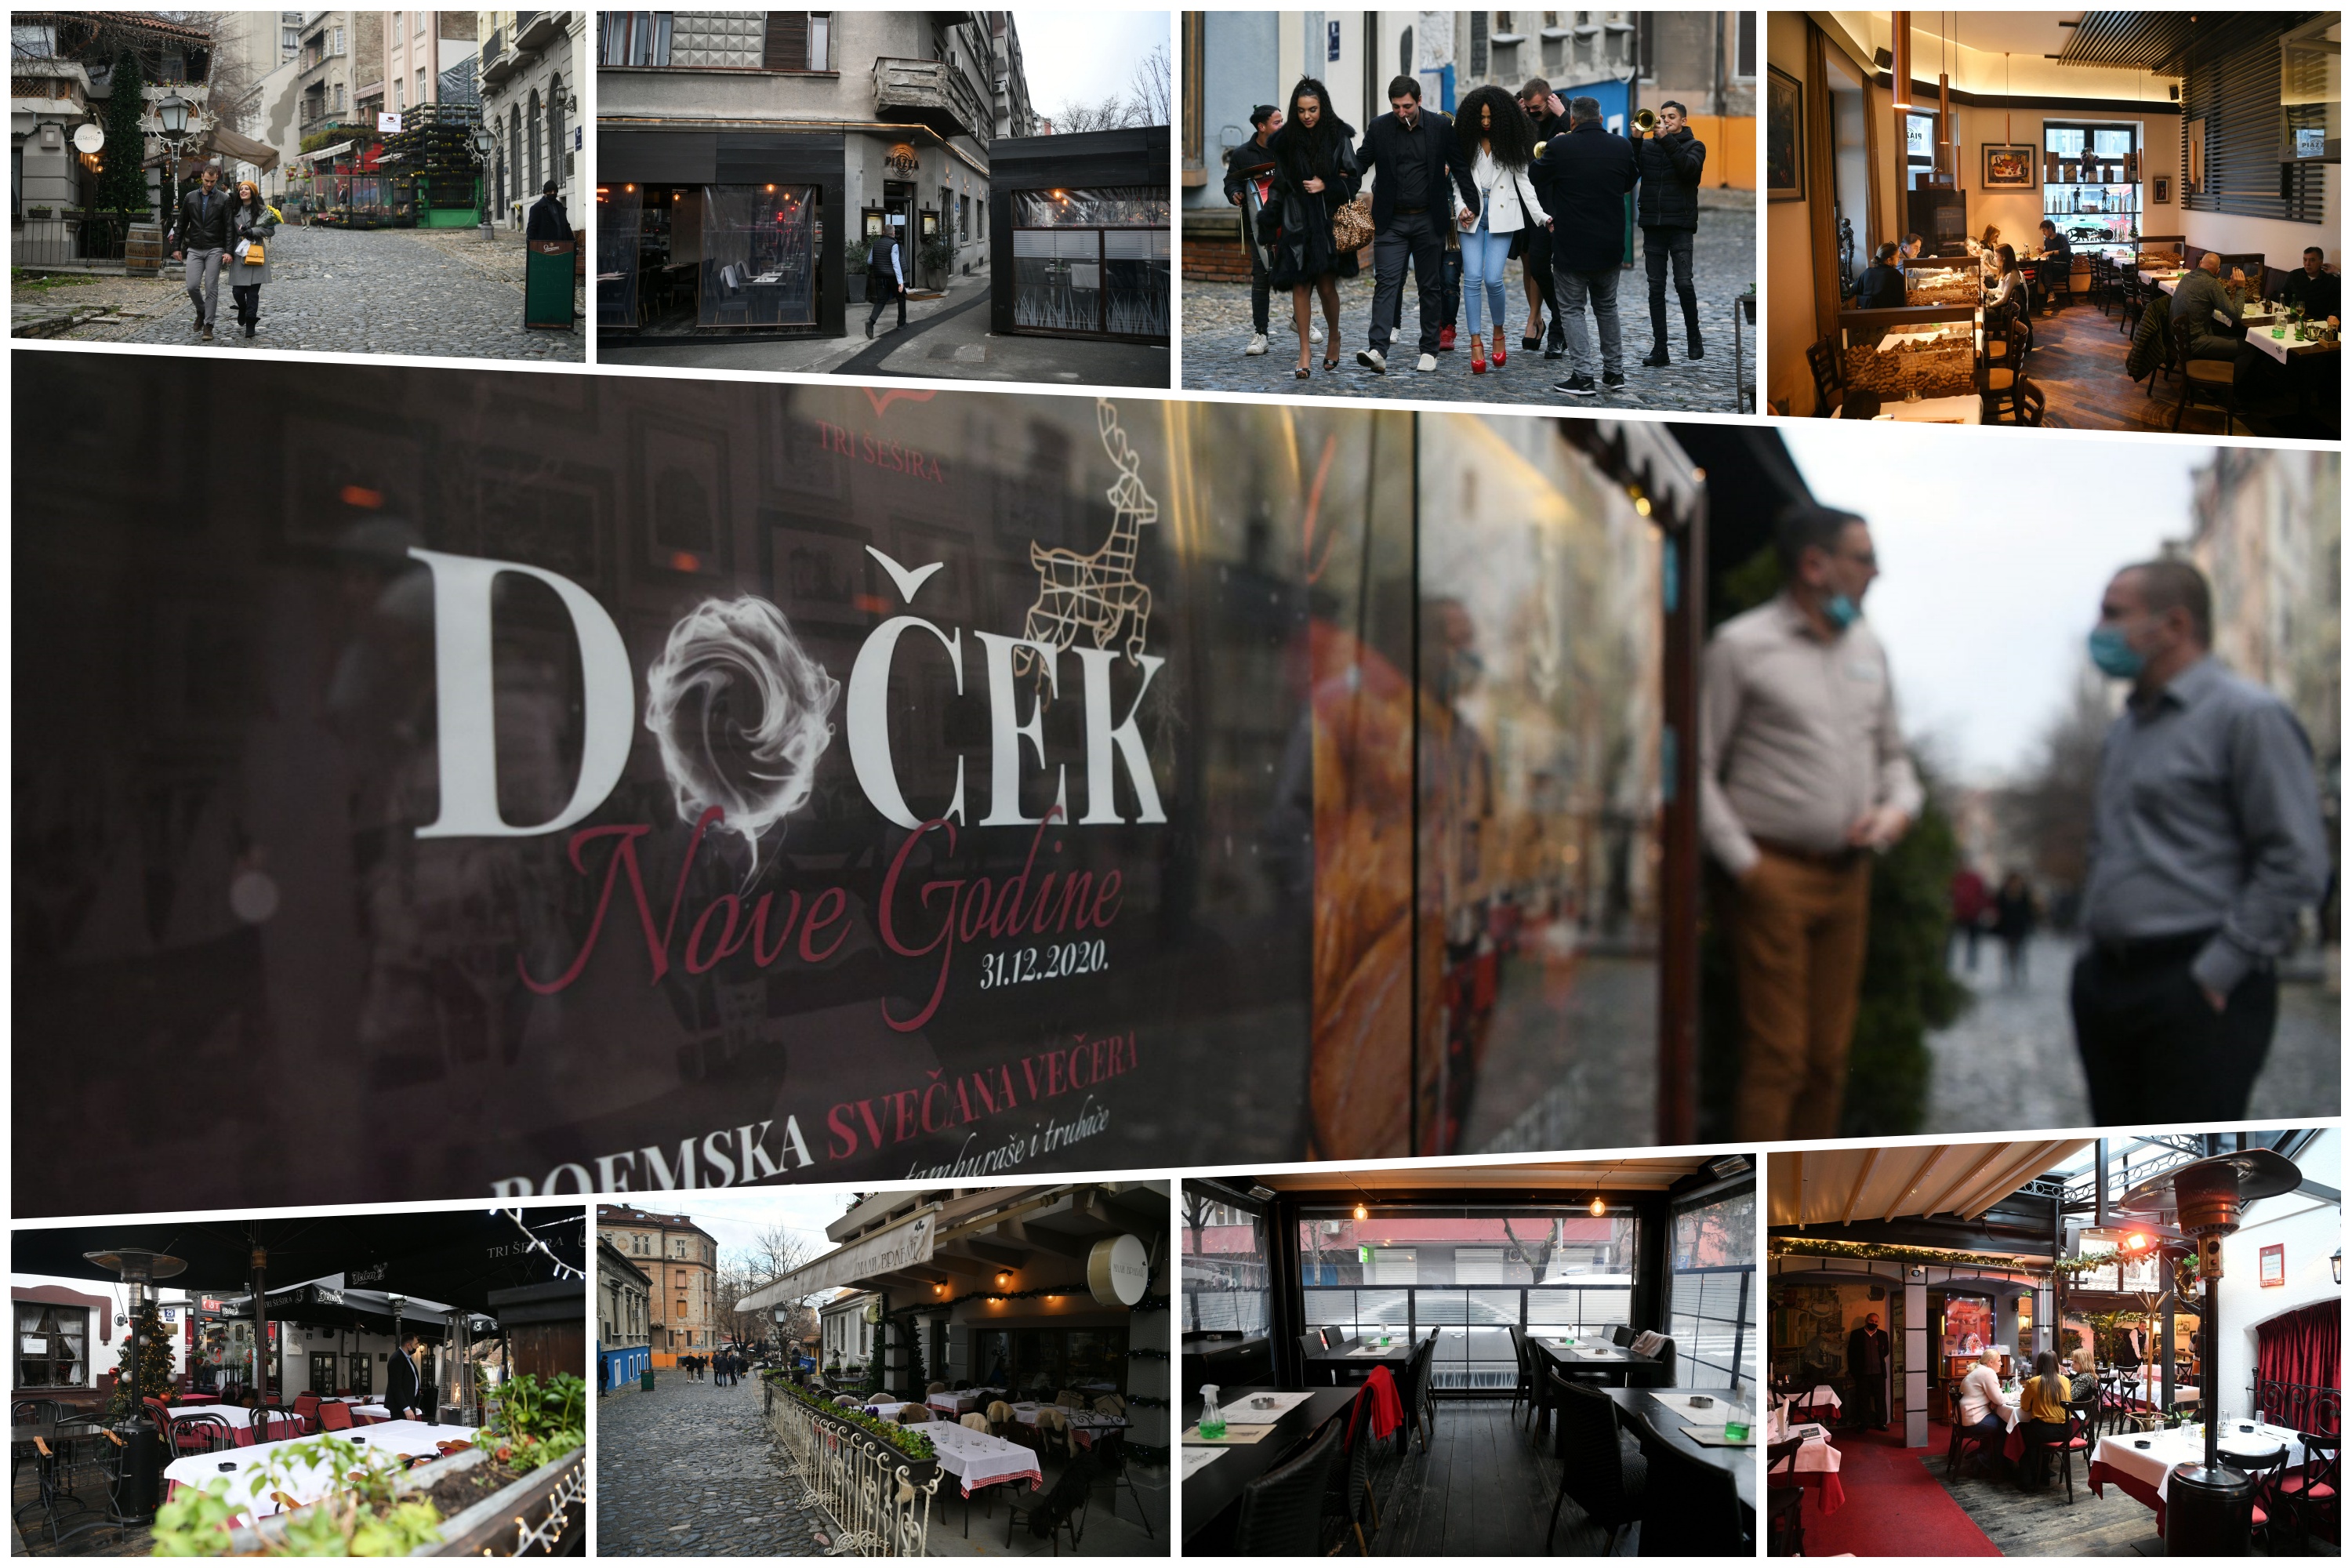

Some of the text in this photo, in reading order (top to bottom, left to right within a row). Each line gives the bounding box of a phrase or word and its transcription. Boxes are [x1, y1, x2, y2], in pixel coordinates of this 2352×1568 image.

[885, 156, 919, 170] PIAZZA
[816, 419, 944, 484] TRI ŠEŠIRA
[408, 545, 1168, 840] DOČEK
[517, 805, 1124, 1033] Nove Godine
[980, 938, 1109, 991] 31.12.2020.
[827, 1066, 1018, 1160] SVEČANA
[1022, 1029, 1139, 1101] VEČERA
[1029, 1123, 1040, 1157] i
[1044, 1094, 1110, 1153] trubače
[351, 1270, 376, 1285] Jelen
[487, 1245, 509, 1258] TRI
[272, 1296, 292, 1307] ŠEŠIRA
[318, 1290, 340, 1305] Jelen
